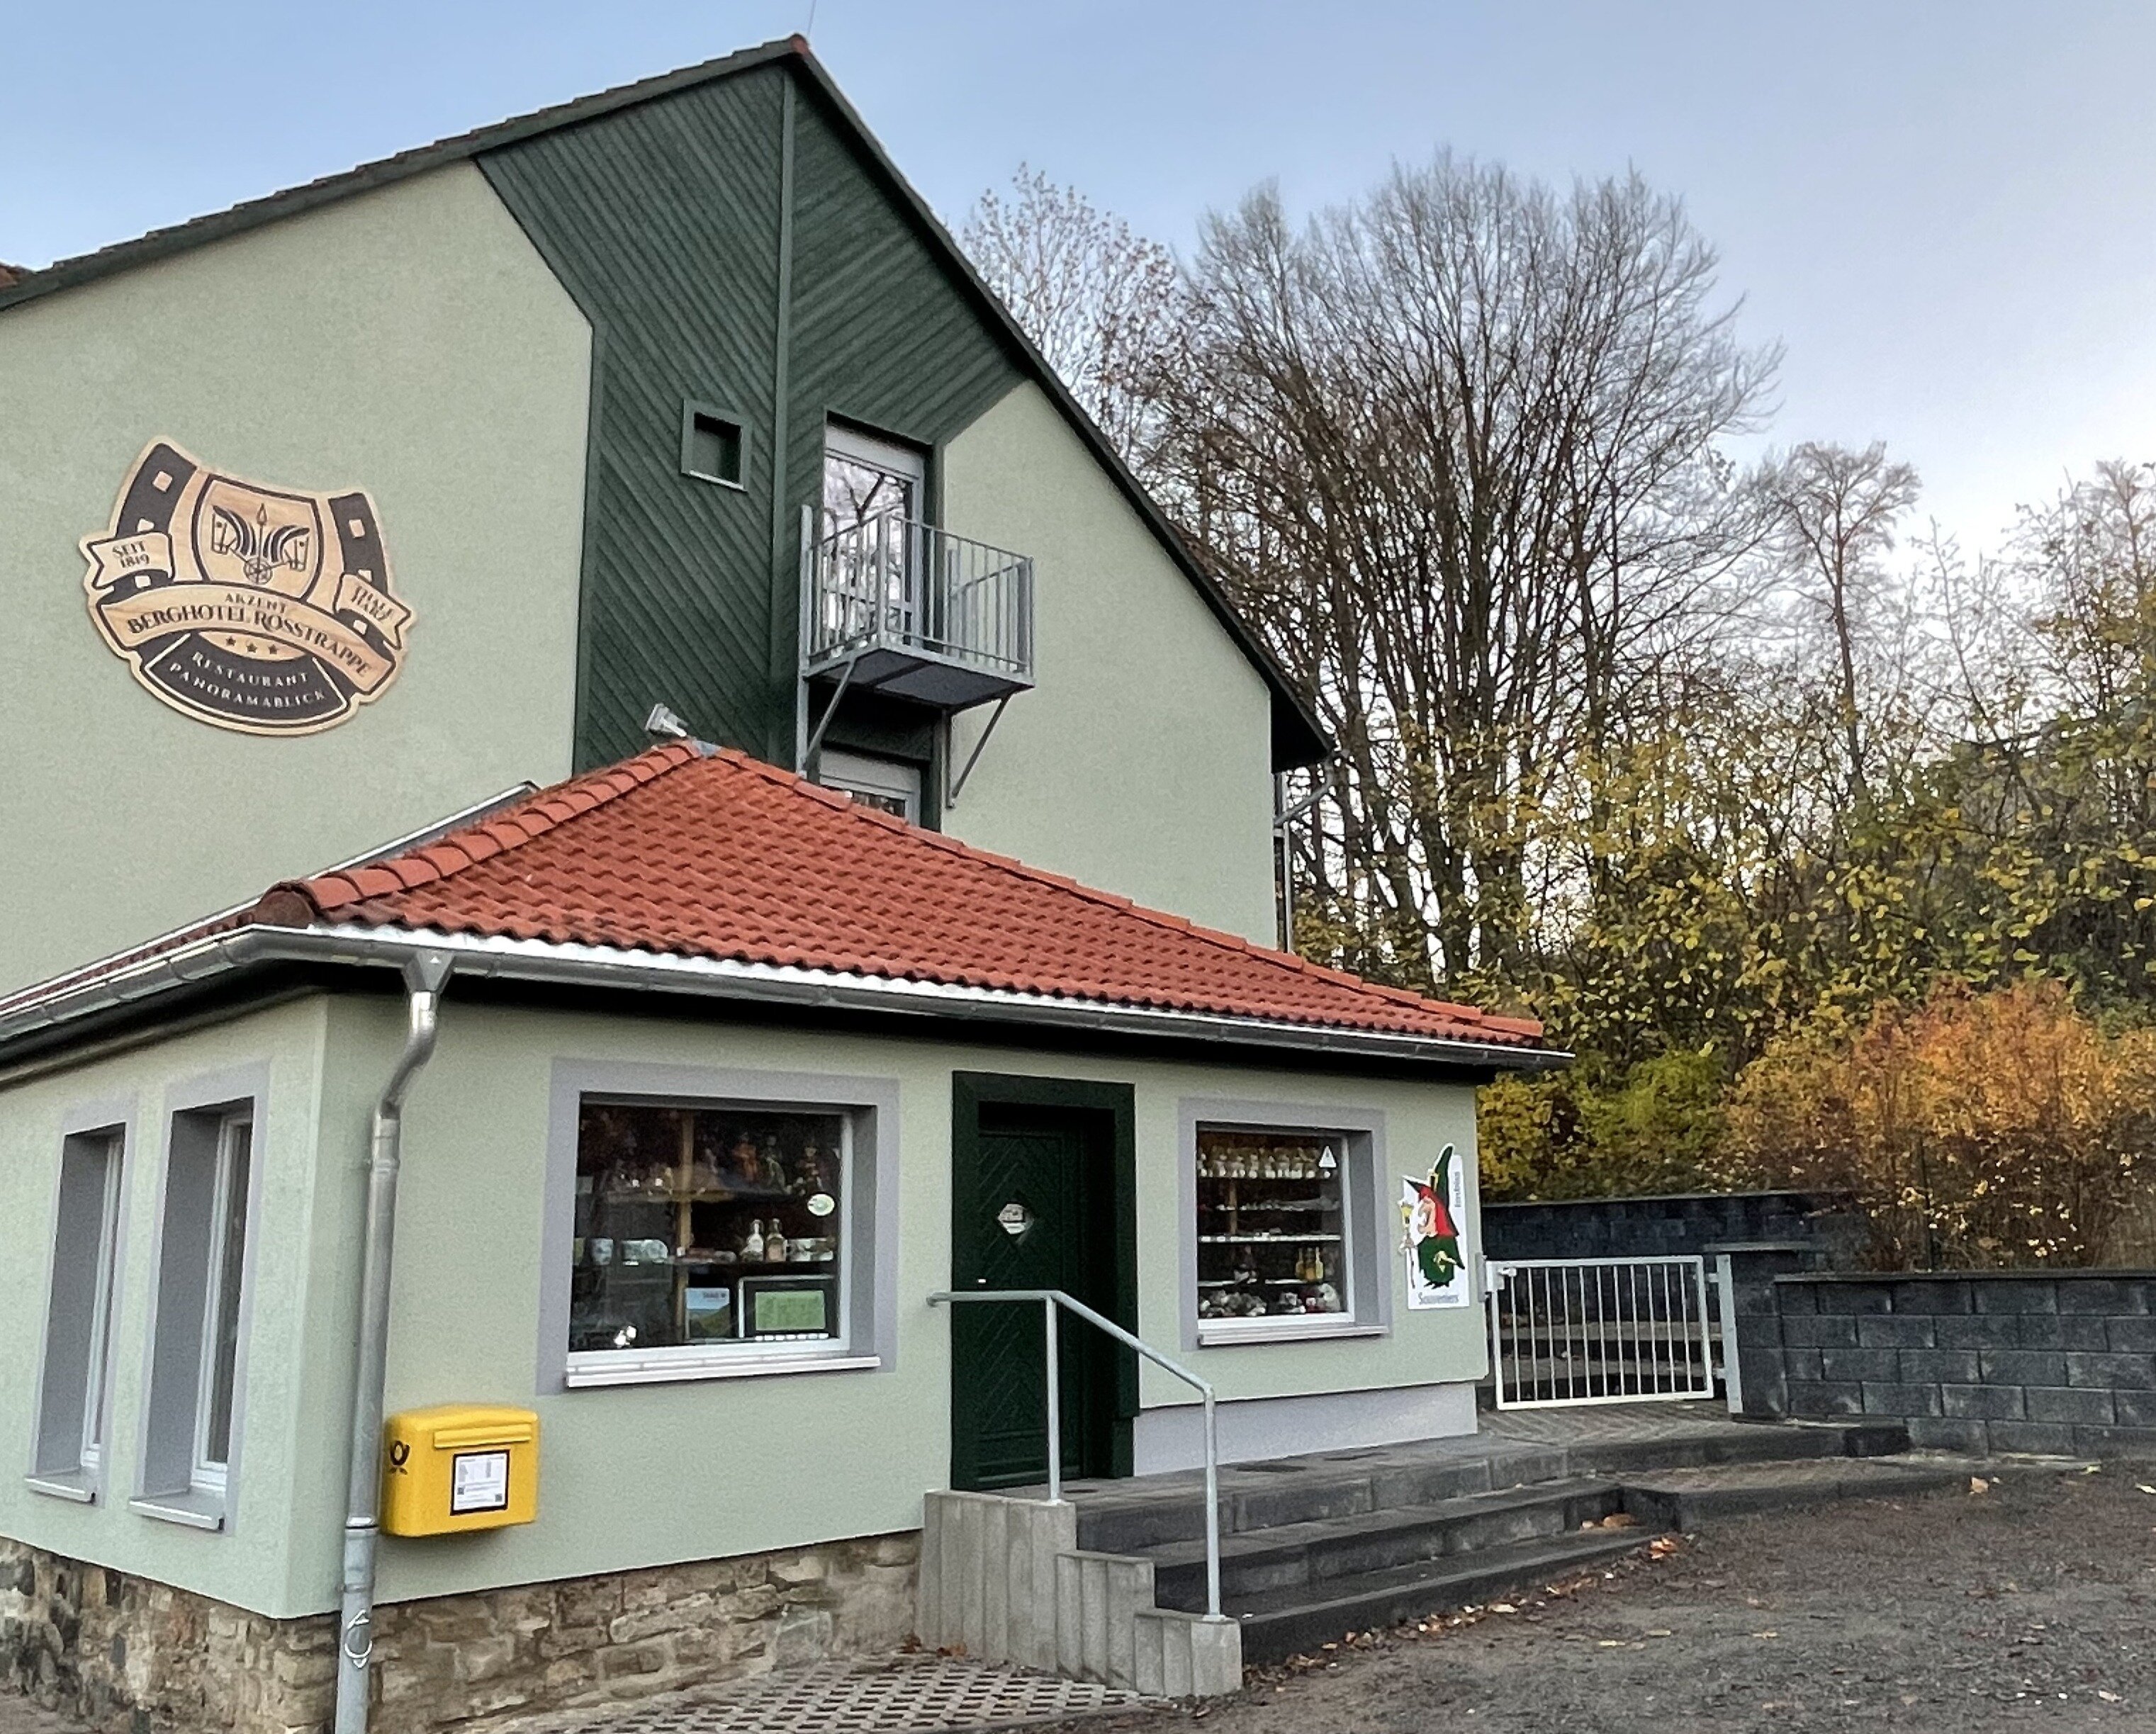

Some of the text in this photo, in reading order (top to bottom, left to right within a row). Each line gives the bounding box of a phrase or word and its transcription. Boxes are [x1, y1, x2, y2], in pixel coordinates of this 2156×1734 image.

[128, 604, 374, 677] BERGHOTEL ROSSTRAPPE
[169, 662, 325, 709] PANORAMABLICK
[191, 651, 308, 687] RESTAURANT
